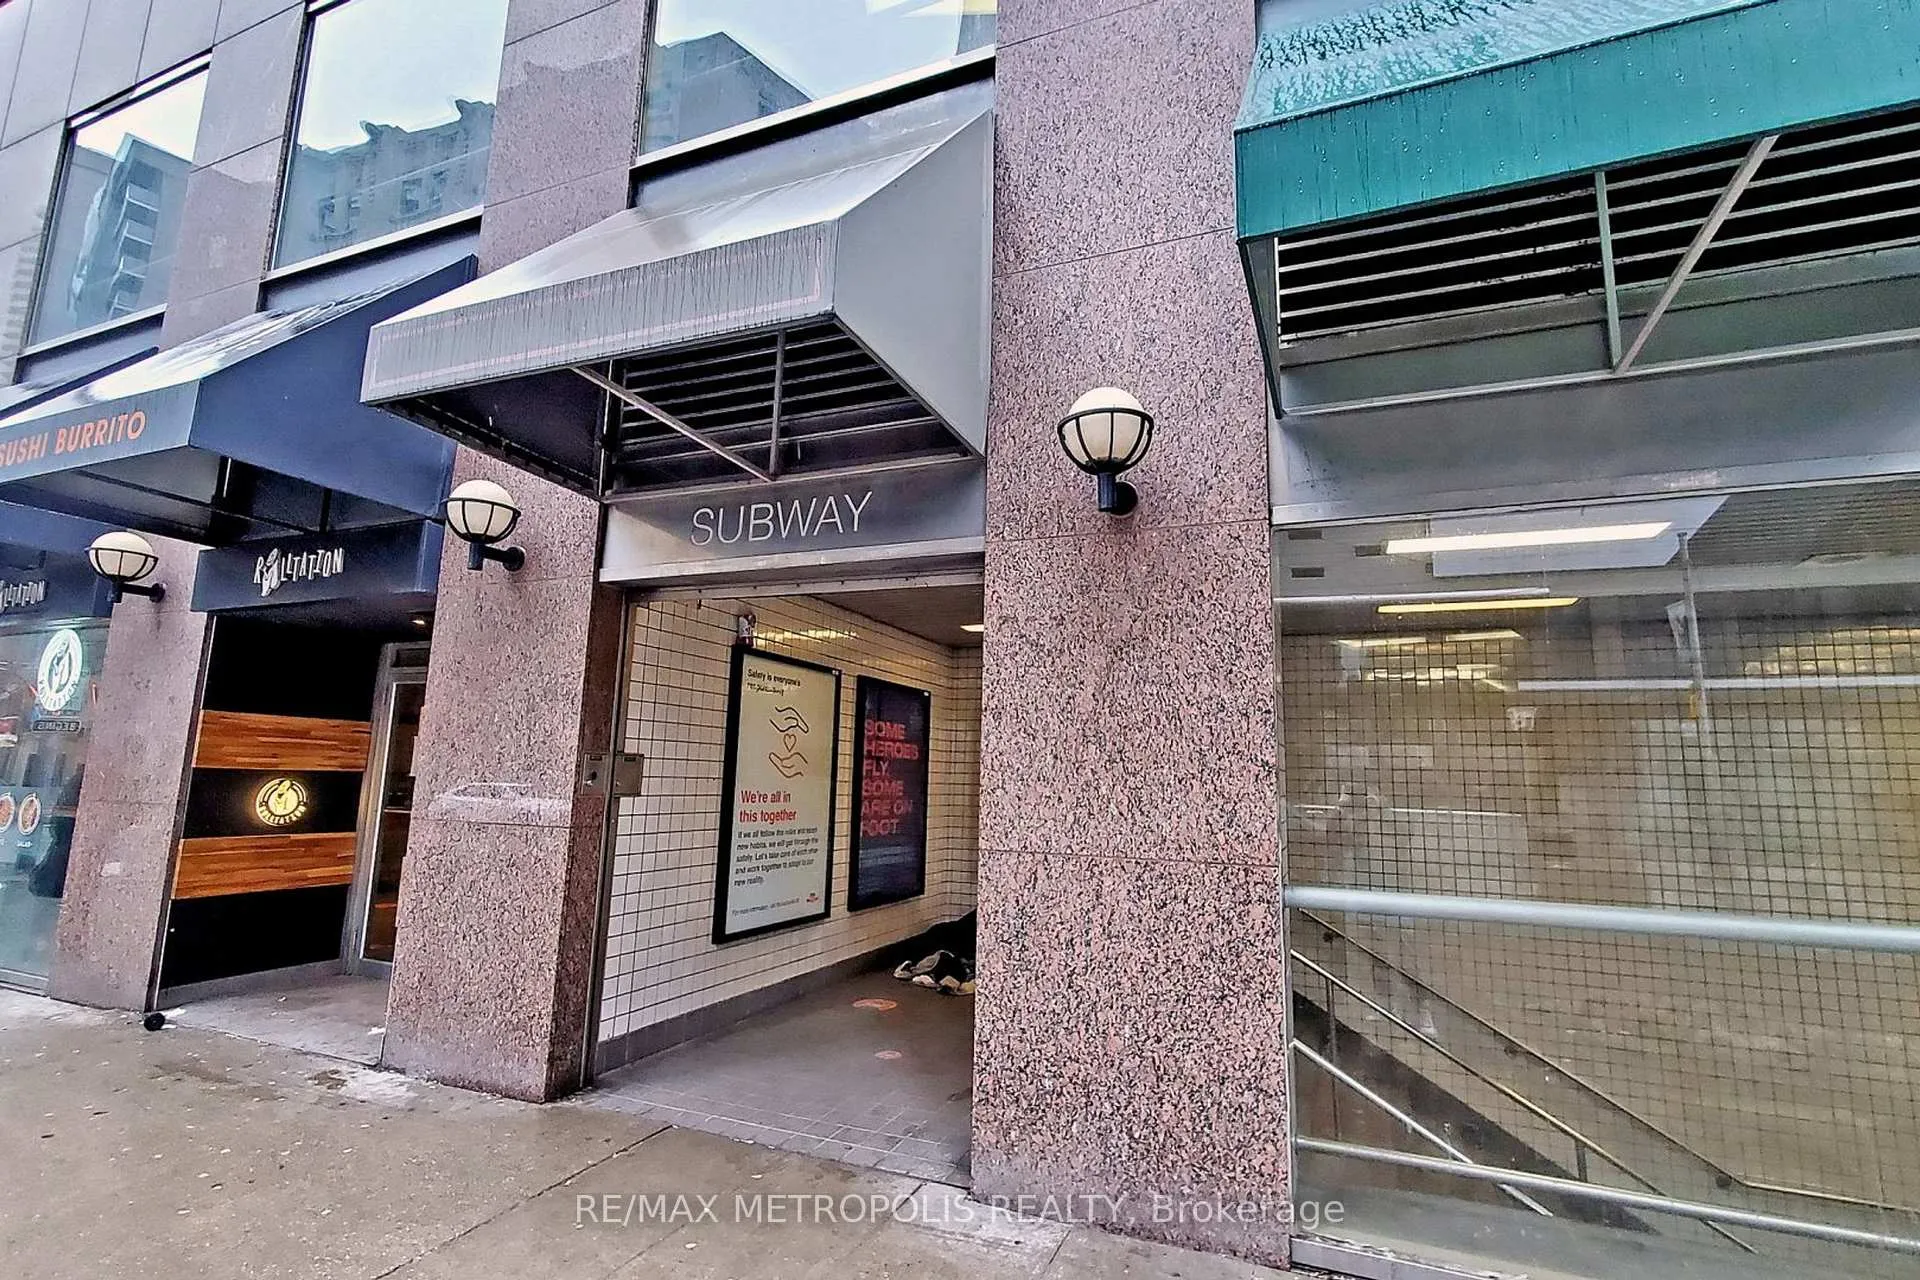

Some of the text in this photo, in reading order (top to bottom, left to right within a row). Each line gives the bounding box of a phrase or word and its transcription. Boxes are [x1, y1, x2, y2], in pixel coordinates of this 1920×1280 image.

[0, 410, 146, 467] SUSHI BURRITO
[690, 491, 873, 546] SUBWAY
[747, 668, 766, 681] Safety
[864, 719, 906, 740] SOME
[863, 740, 919, 760] HEROES
[741, 790, 791, 803] We're all in
[862, 779, 904, 797] SOME
[739, 808, 797, 825] this together
[861, 799, 890, 817] ARE
[860, 818, 900, 838] FOOT
